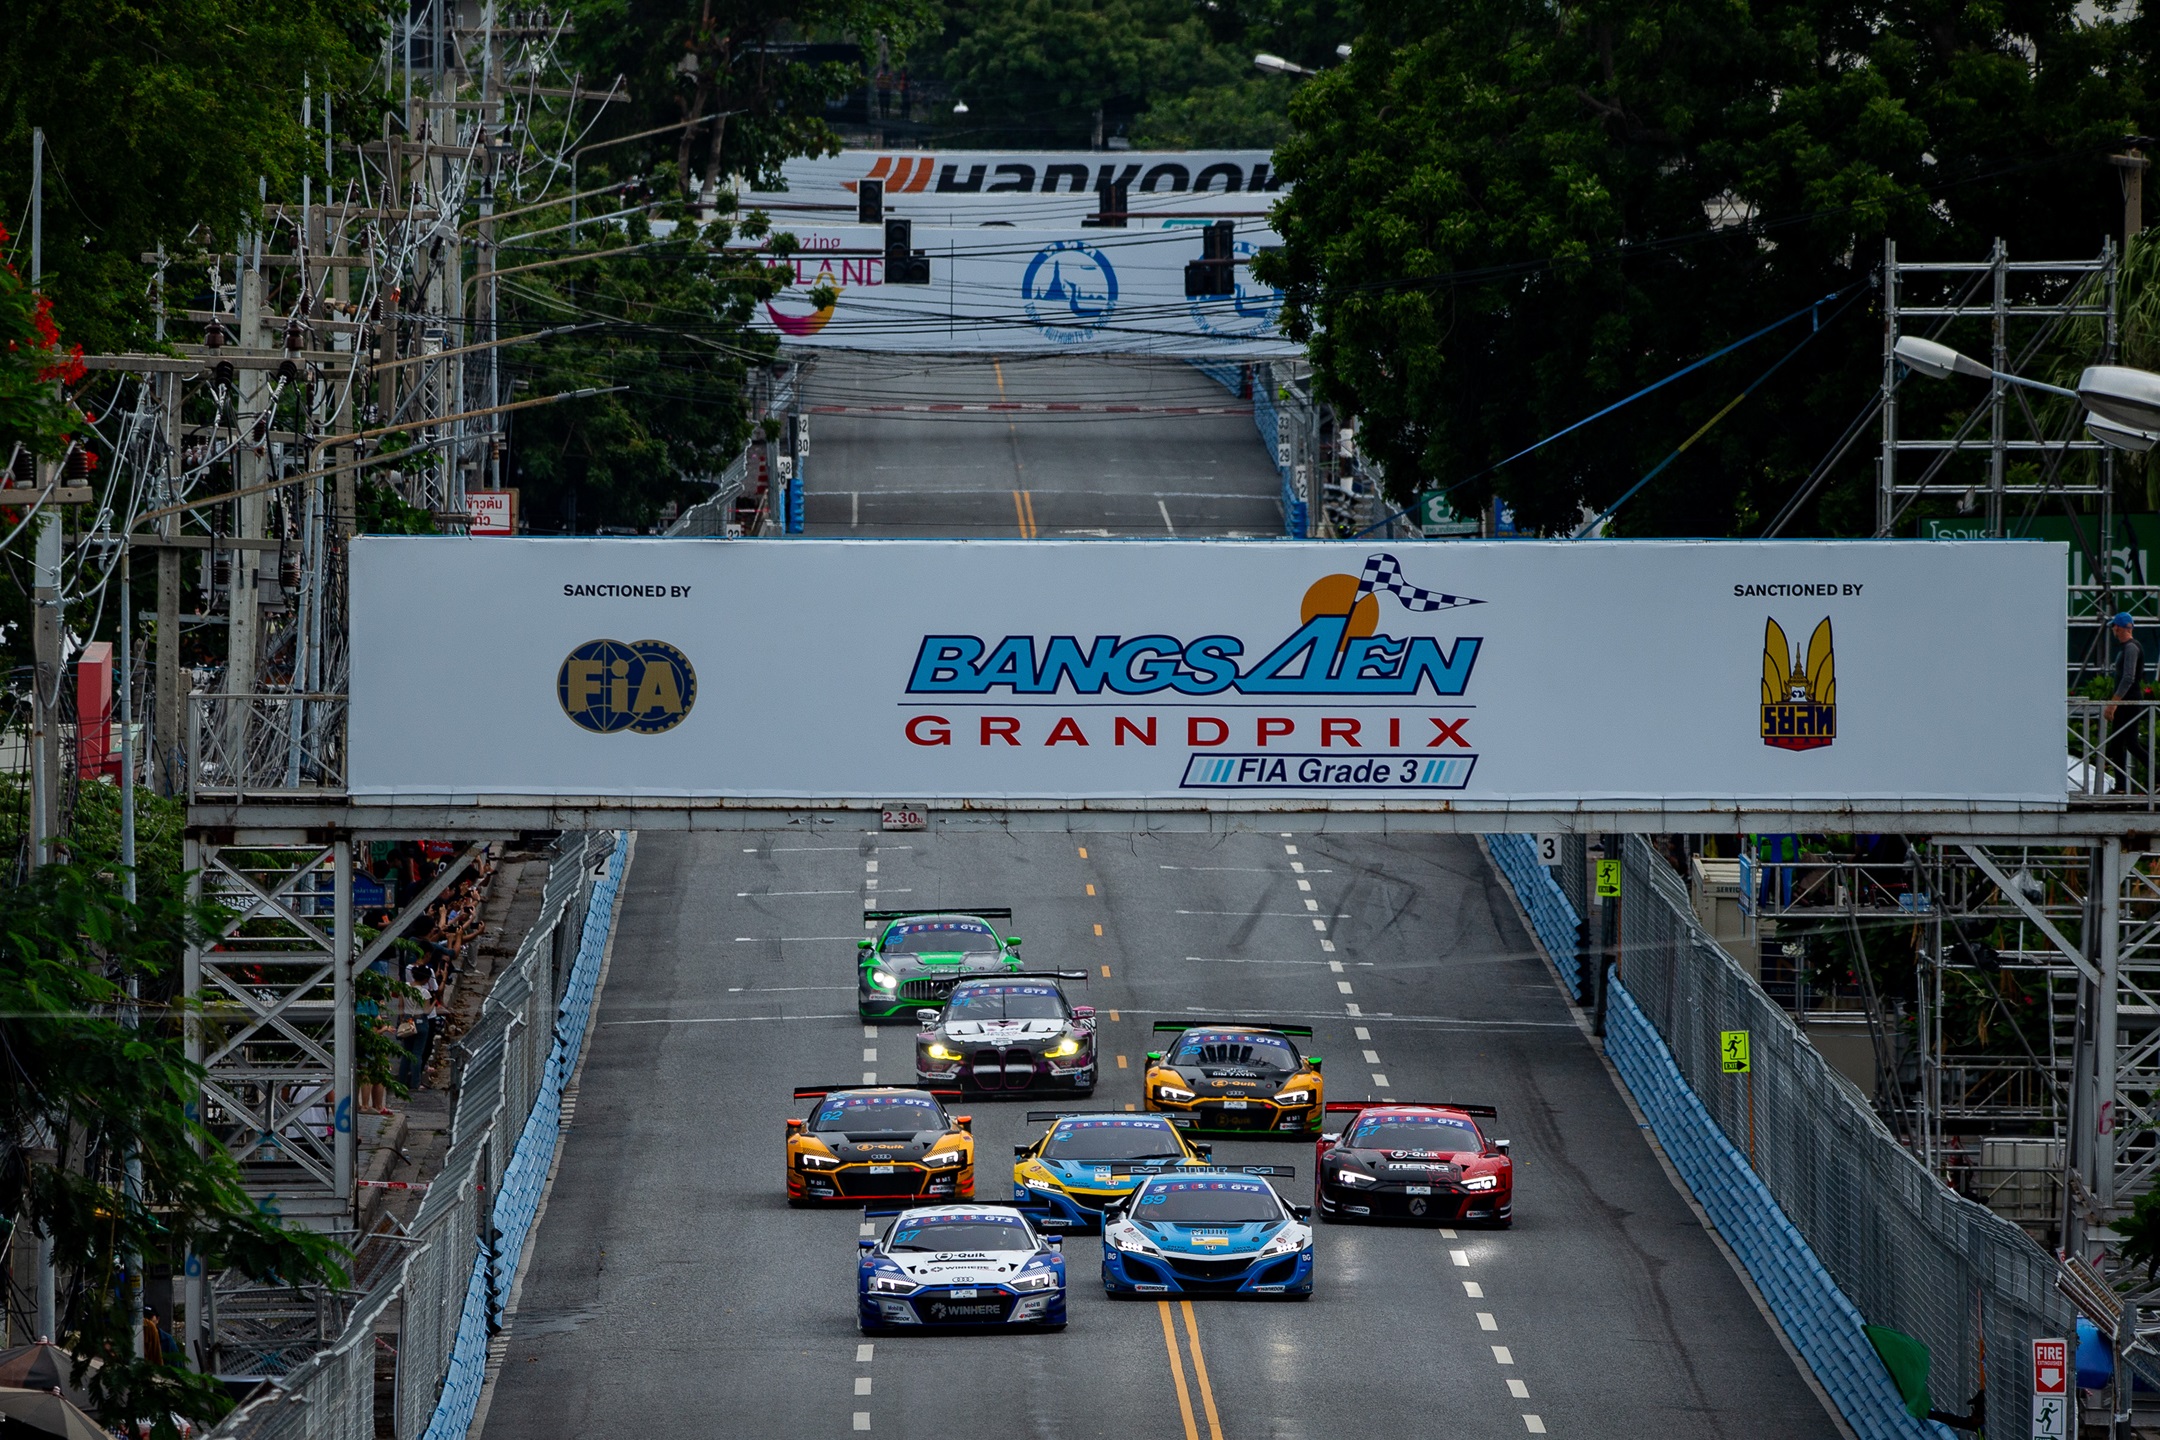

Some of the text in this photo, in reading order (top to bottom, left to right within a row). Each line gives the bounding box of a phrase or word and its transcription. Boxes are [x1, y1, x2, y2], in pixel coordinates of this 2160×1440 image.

[761, 233, 841, 253] azing
[1279, 448, 1290, 462] 29
[563, 584, 692, 598] SANCTIONED BY
[1733, 583, 1864, 597] SANCTIONED BY
[905, 614, 1484, 697] BANGSAEN
[1237, 758, 1419, 784] FIA Grade 3
[1543, 838, 1555, 860] 3
[951, 997, 971, 1007] 91
[1180, 1045, 1202, 1055] 25
[1724, 1062, 1738, 1070] EXIT
[819, 1110, 844, 1122] 62
[1357, 1125, 1381, 1138] 27
[1140, 1194, 1167, 1206] 89
[895, 1229, 921, 1243] 37
[1107, 1252, 1117, 1261] BG
[1302, 1253, 1312, 1262] BG
[948, 1304, 1001, 1315] WINHERE
[2036, 1346, 2063, 1360] FIRE
